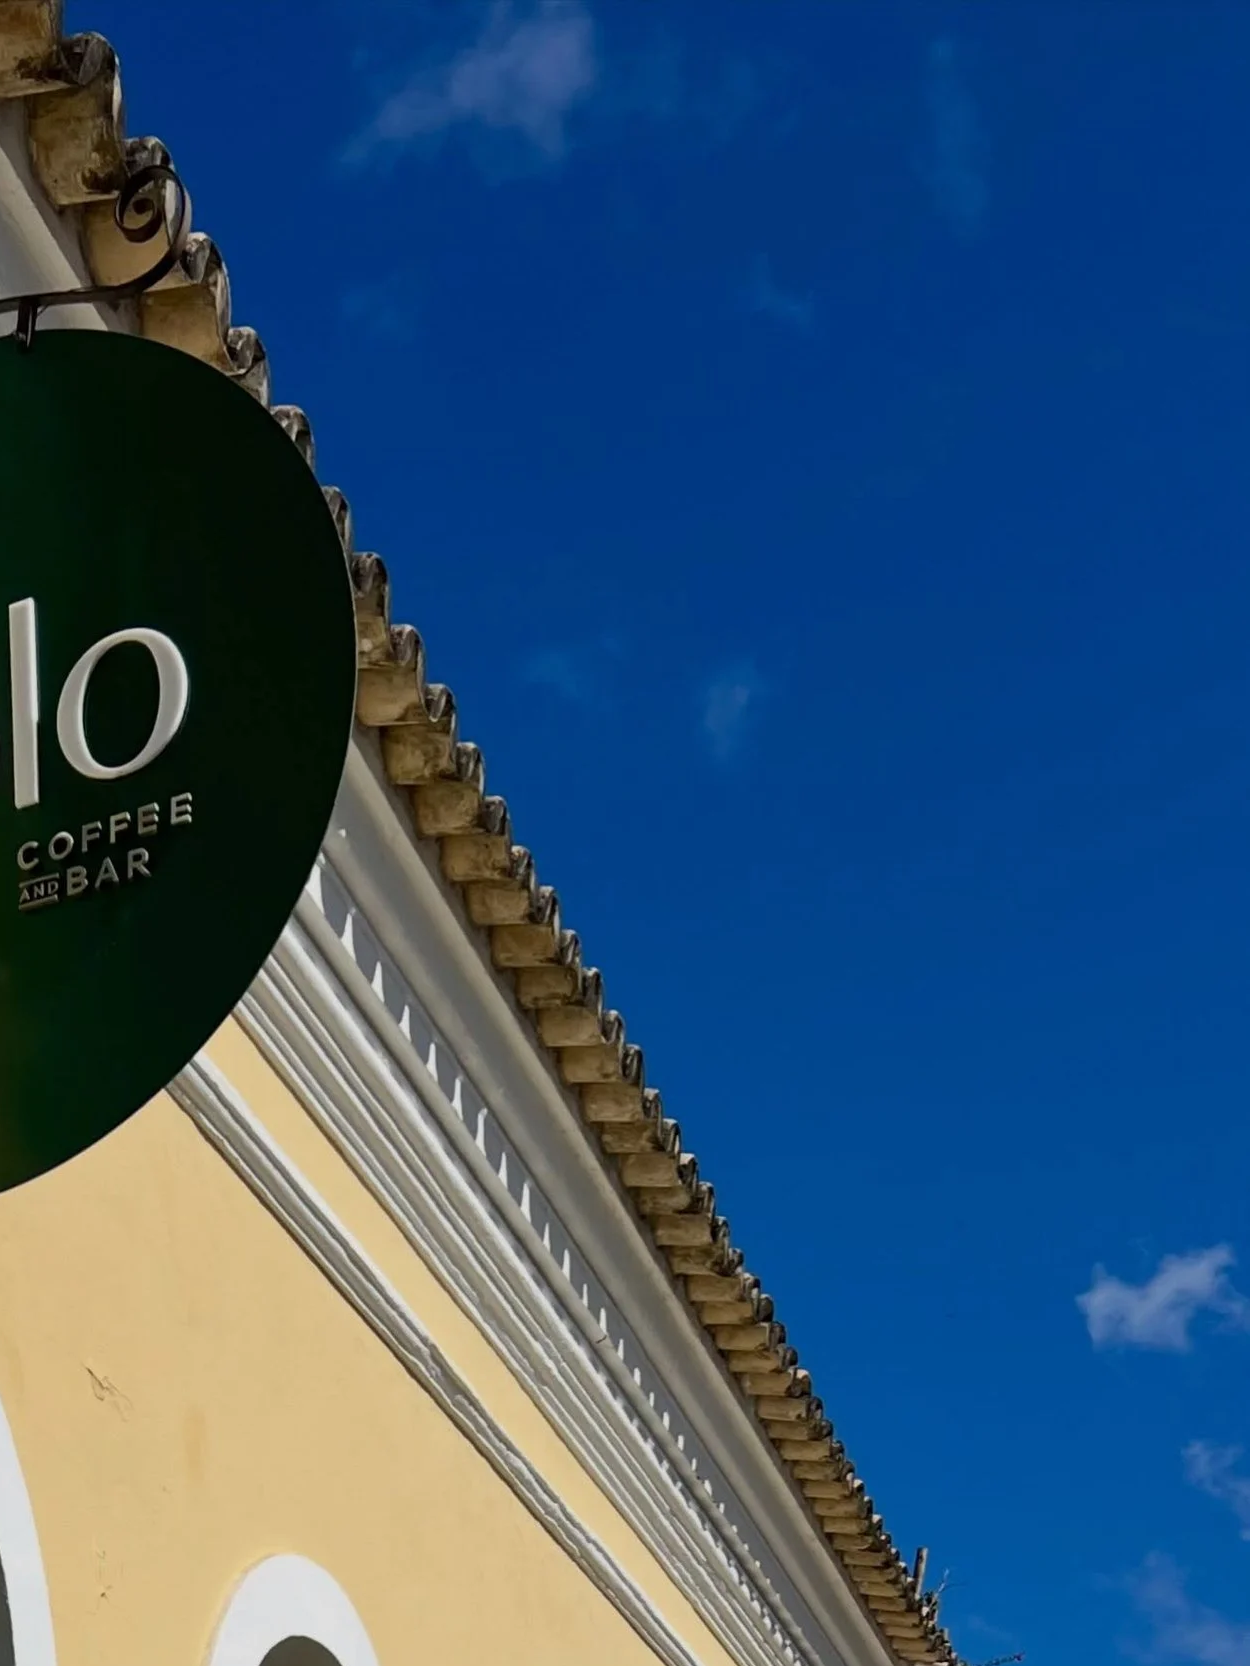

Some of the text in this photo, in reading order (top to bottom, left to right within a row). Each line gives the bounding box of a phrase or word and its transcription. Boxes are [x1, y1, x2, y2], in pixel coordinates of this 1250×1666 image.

[16, 792, 193, 871] COFFEE
[18, 847, 152, 904] AND BAR
